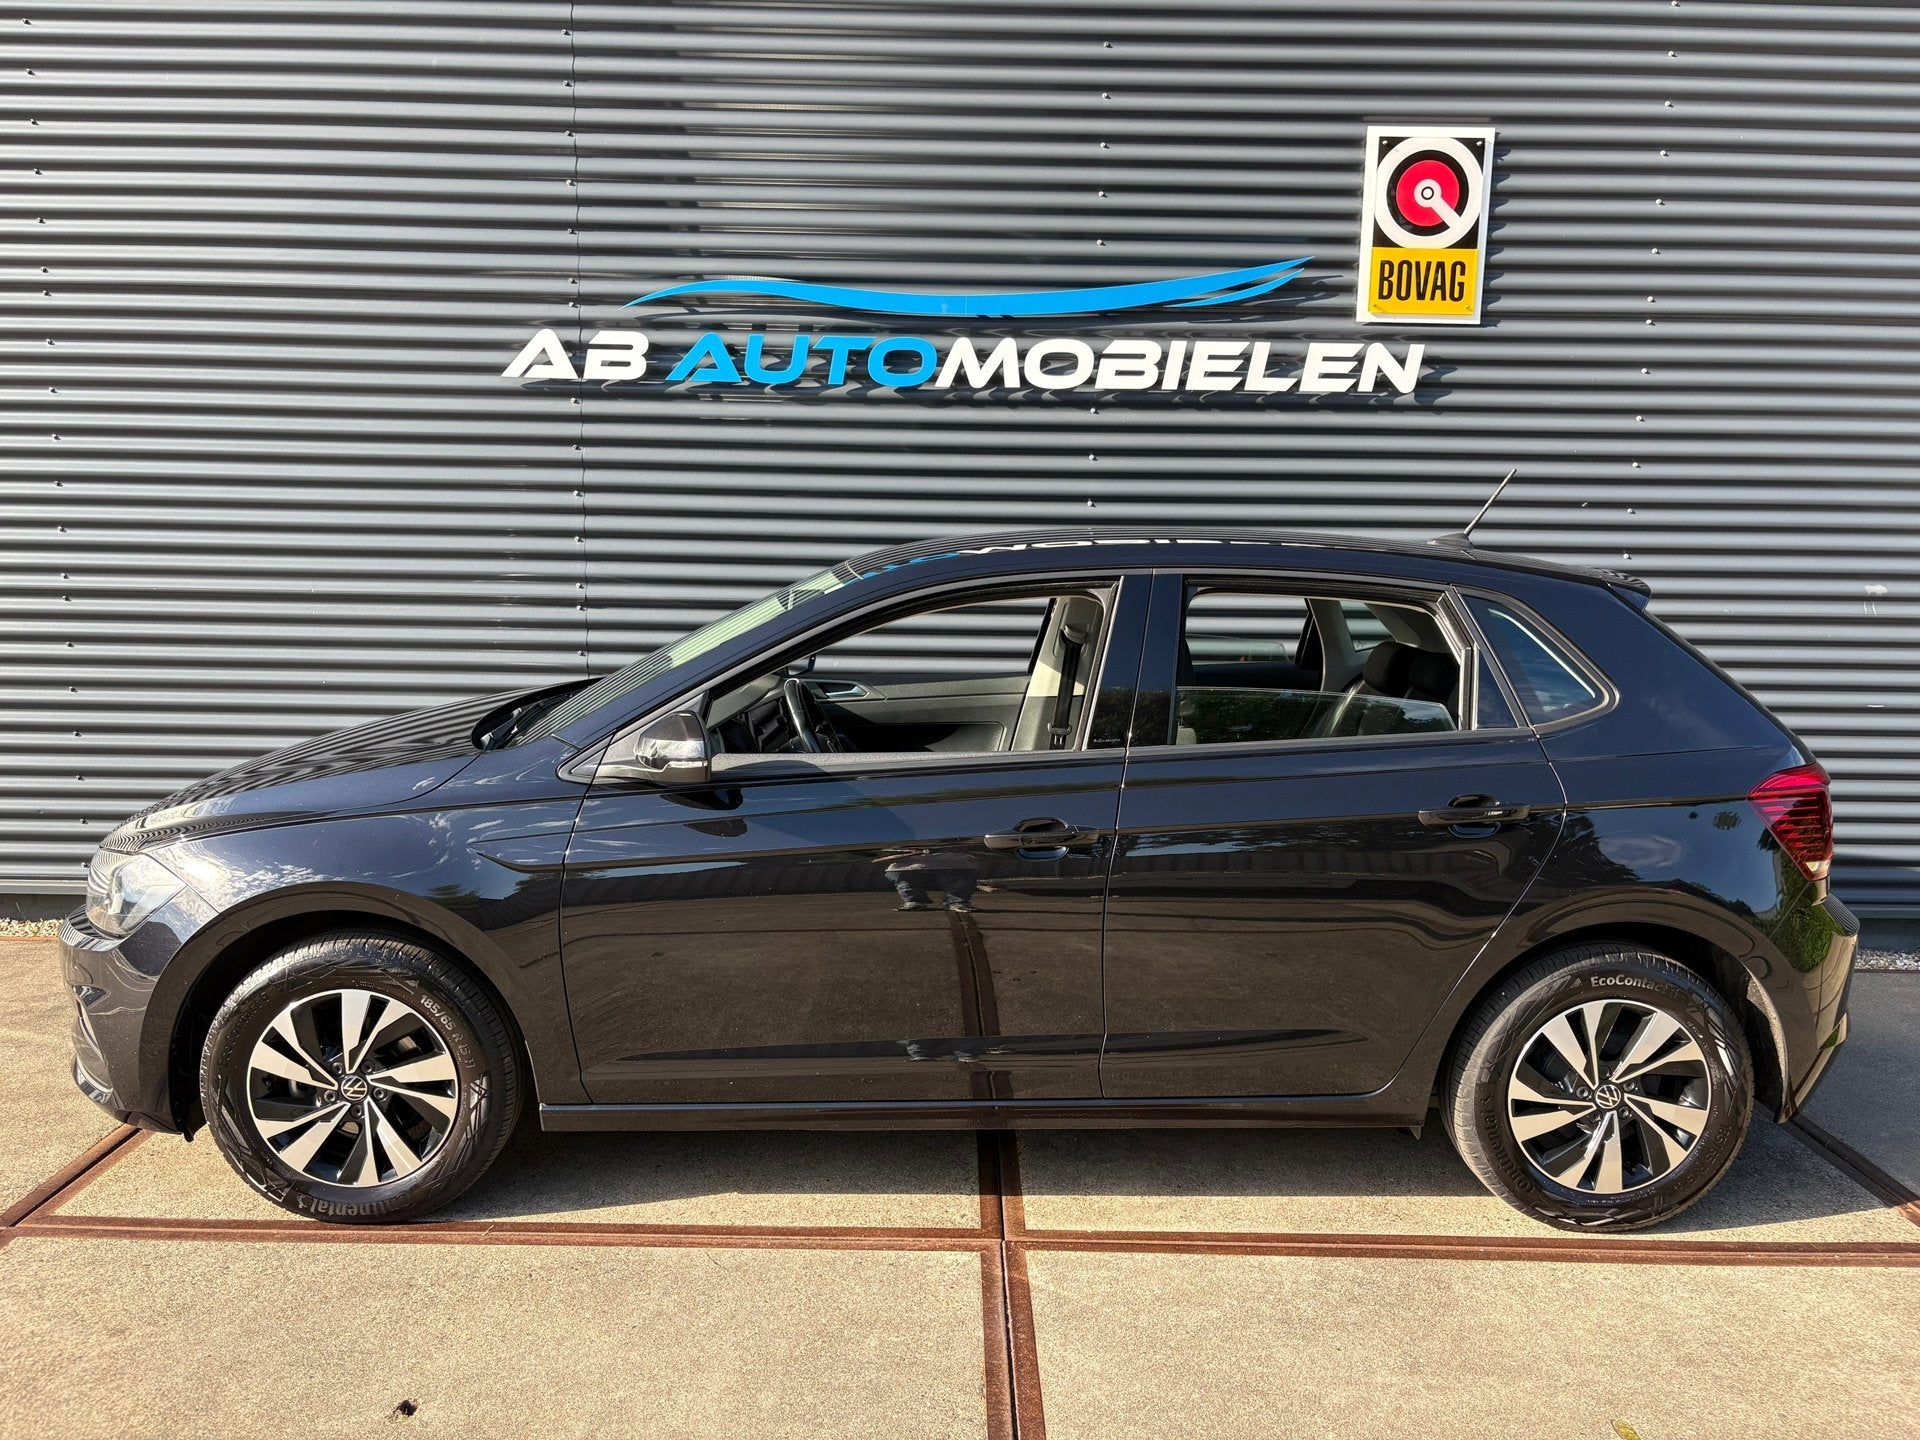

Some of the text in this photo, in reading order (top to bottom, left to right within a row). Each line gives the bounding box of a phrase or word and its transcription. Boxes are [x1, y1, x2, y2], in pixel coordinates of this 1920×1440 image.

[1378, 259, 1466, 302] BOVAG
[501, 328, 1426, 394] AB AUTOMOBIELEN
[420, 994, 457, 1031] 185/65
